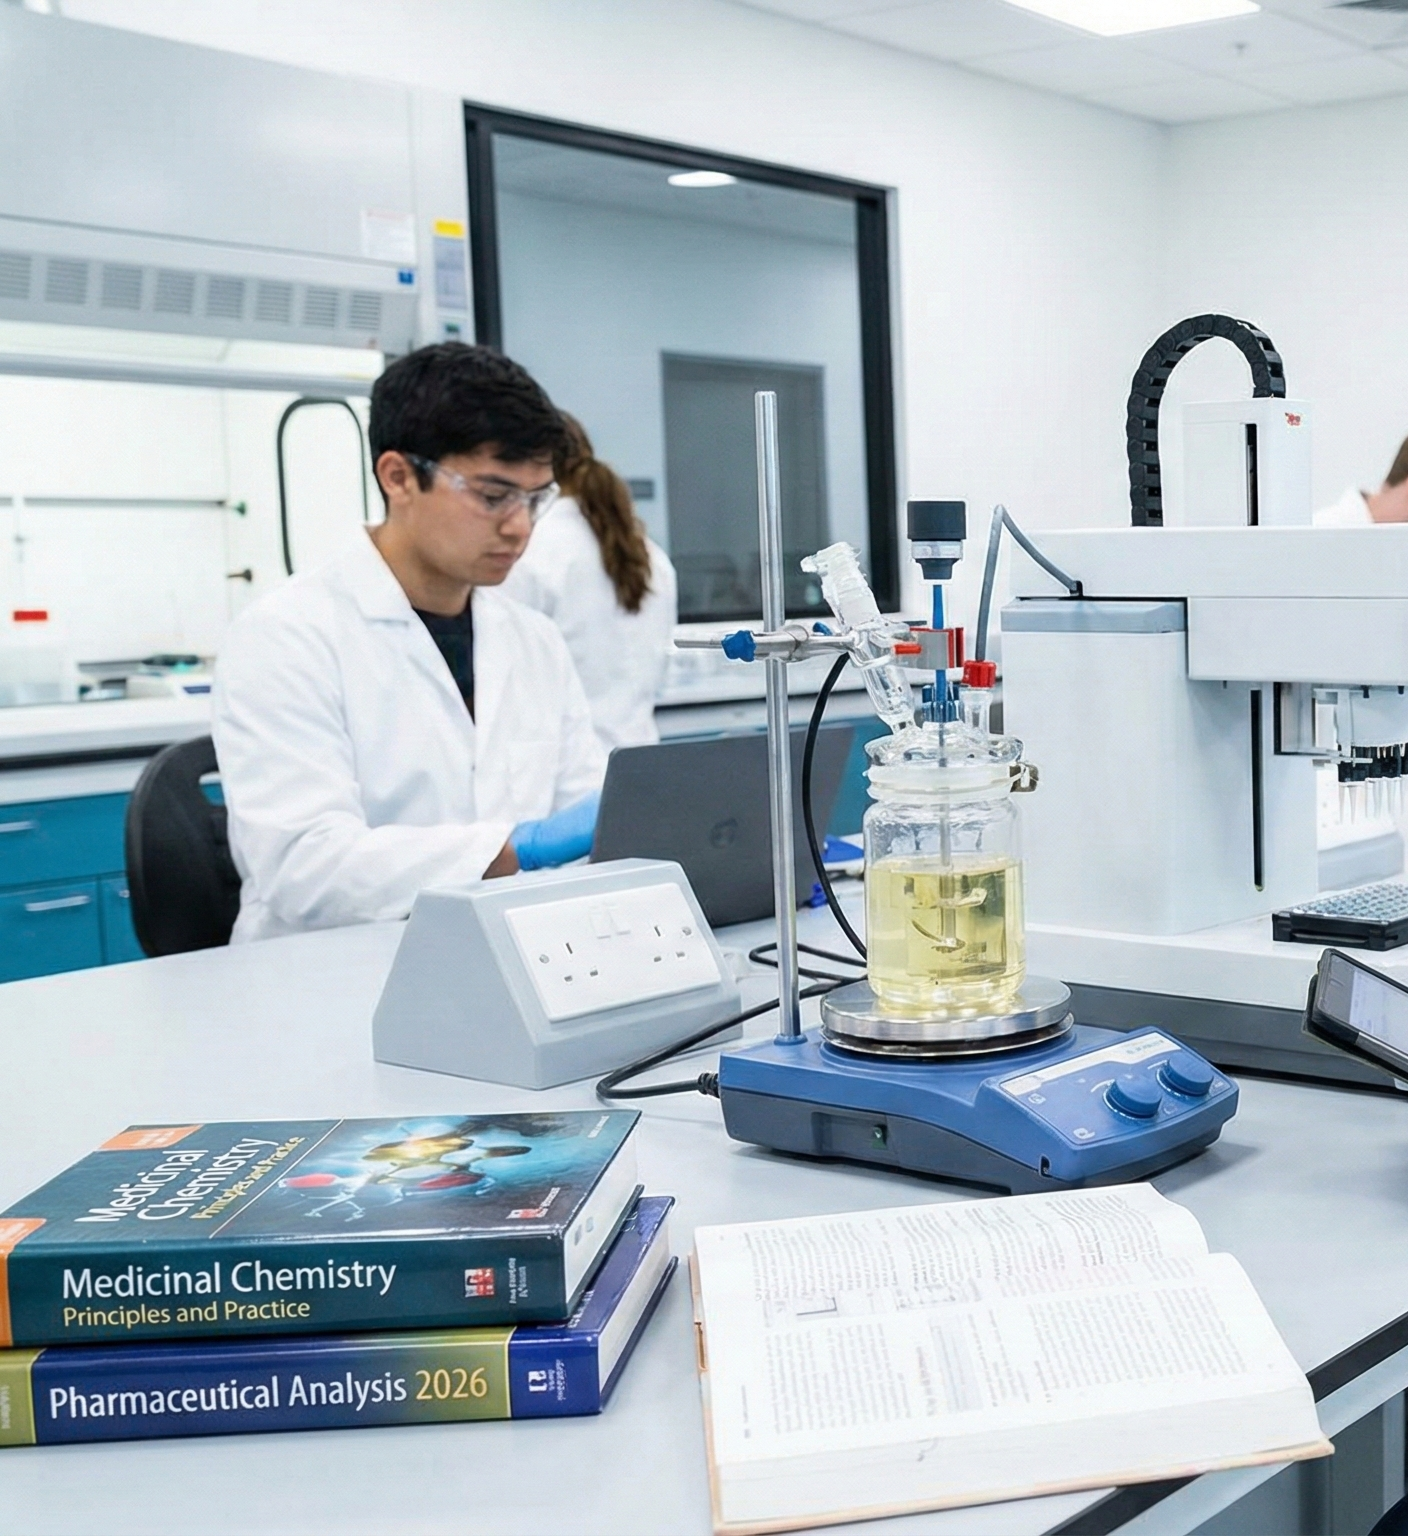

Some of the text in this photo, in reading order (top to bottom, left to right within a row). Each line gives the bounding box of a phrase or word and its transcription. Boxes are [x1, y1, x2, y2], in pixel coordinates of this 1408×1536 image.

[74, 1150, 209, 1222] Medicinal
[137, 1138, 278, 1221] Chemistry
[63, 1259, 397, 1299] Medicinal Chemistry
[63, 1299, 311, 1329] Principles and Practice
[50, 1376, 280, 1419] Pharmaceutical
[289, 1372, 407, 1411] Analysis
[415, 1367, 488, 1401] 2026
